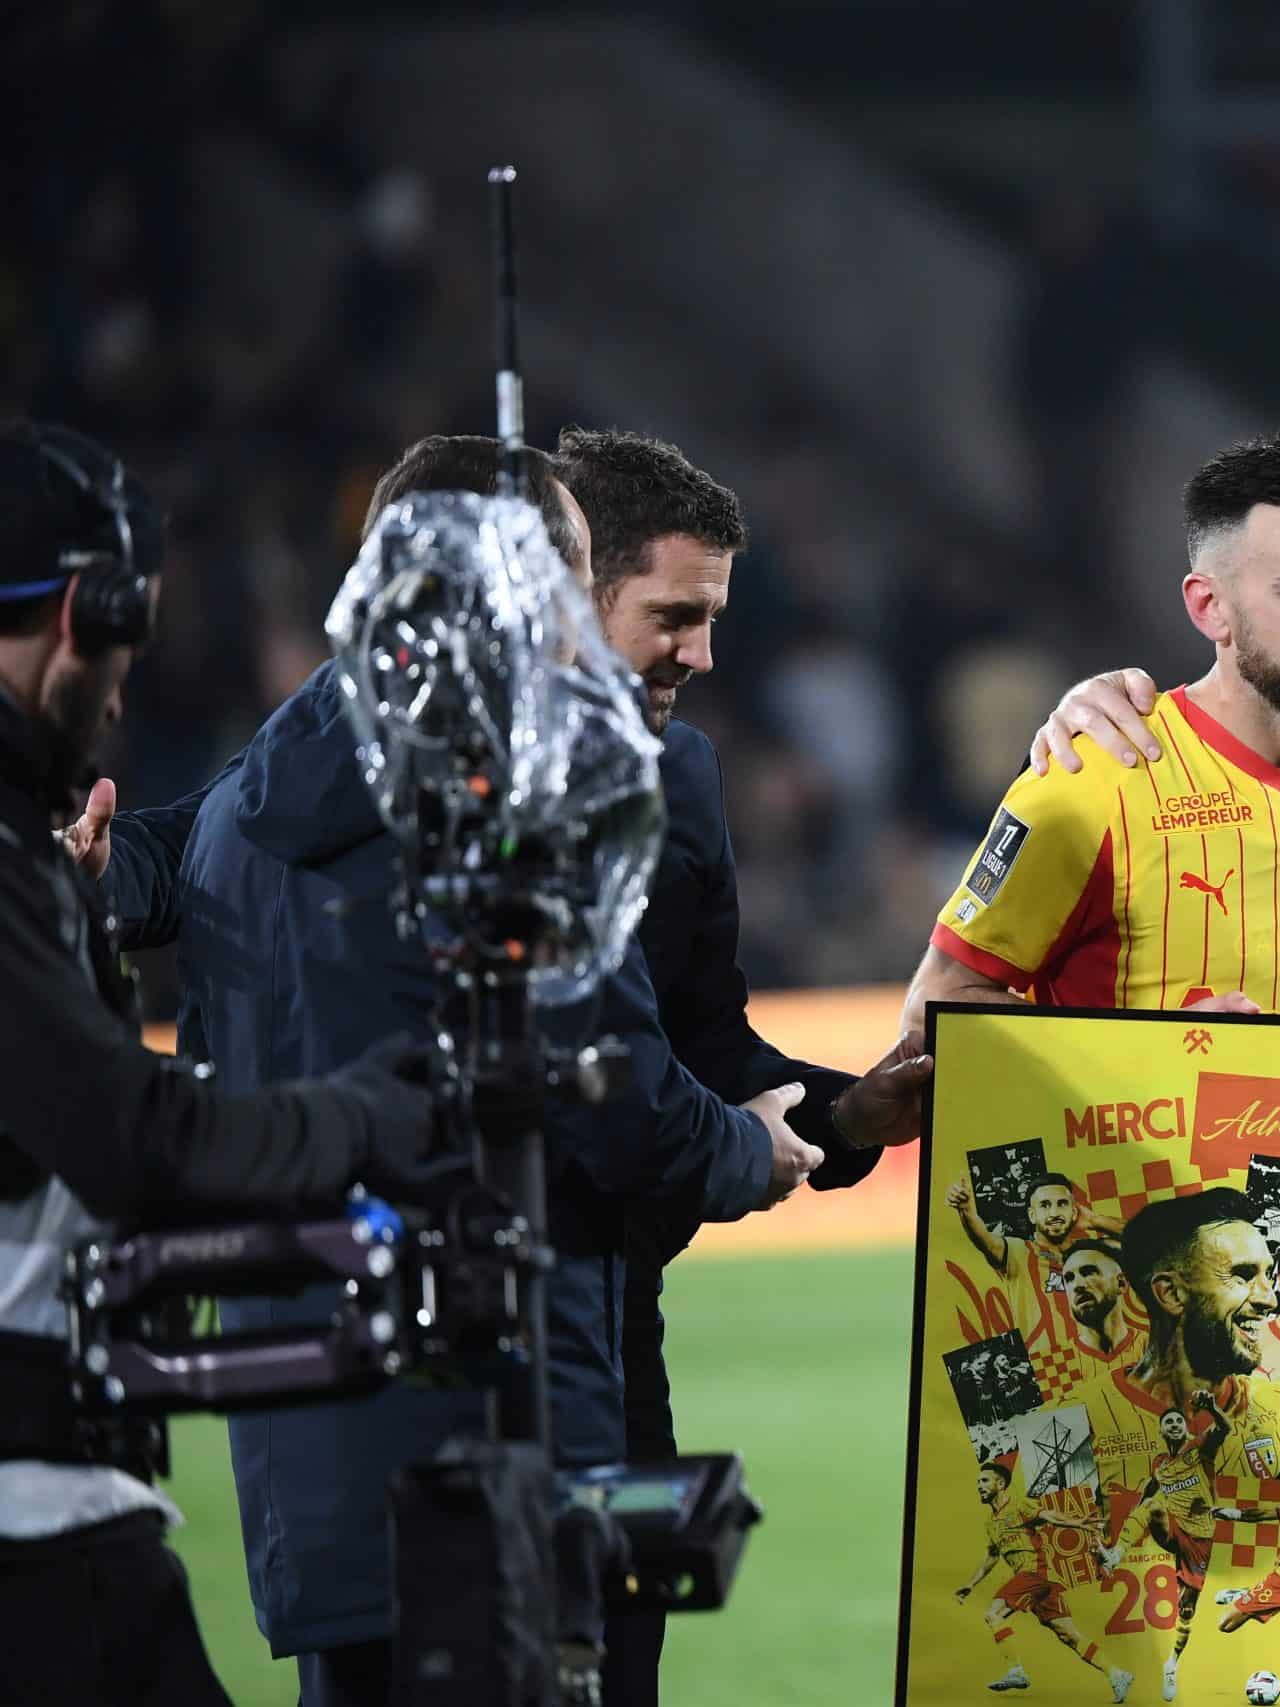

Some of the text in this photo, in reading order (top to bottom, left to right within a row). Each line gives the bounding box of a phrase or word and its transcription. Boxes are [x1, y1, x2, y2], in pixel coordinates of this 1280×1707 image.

[1166, 792, 1232, 812] GROUPE
[1152, 806, 1253, 831] LEMPEREUR
[1064, 1097, 1187, 1148] MERCI
[1102, 1440, 1159, 1457] MPEREUR
[1101, 1564, 1178, 1636] 28
